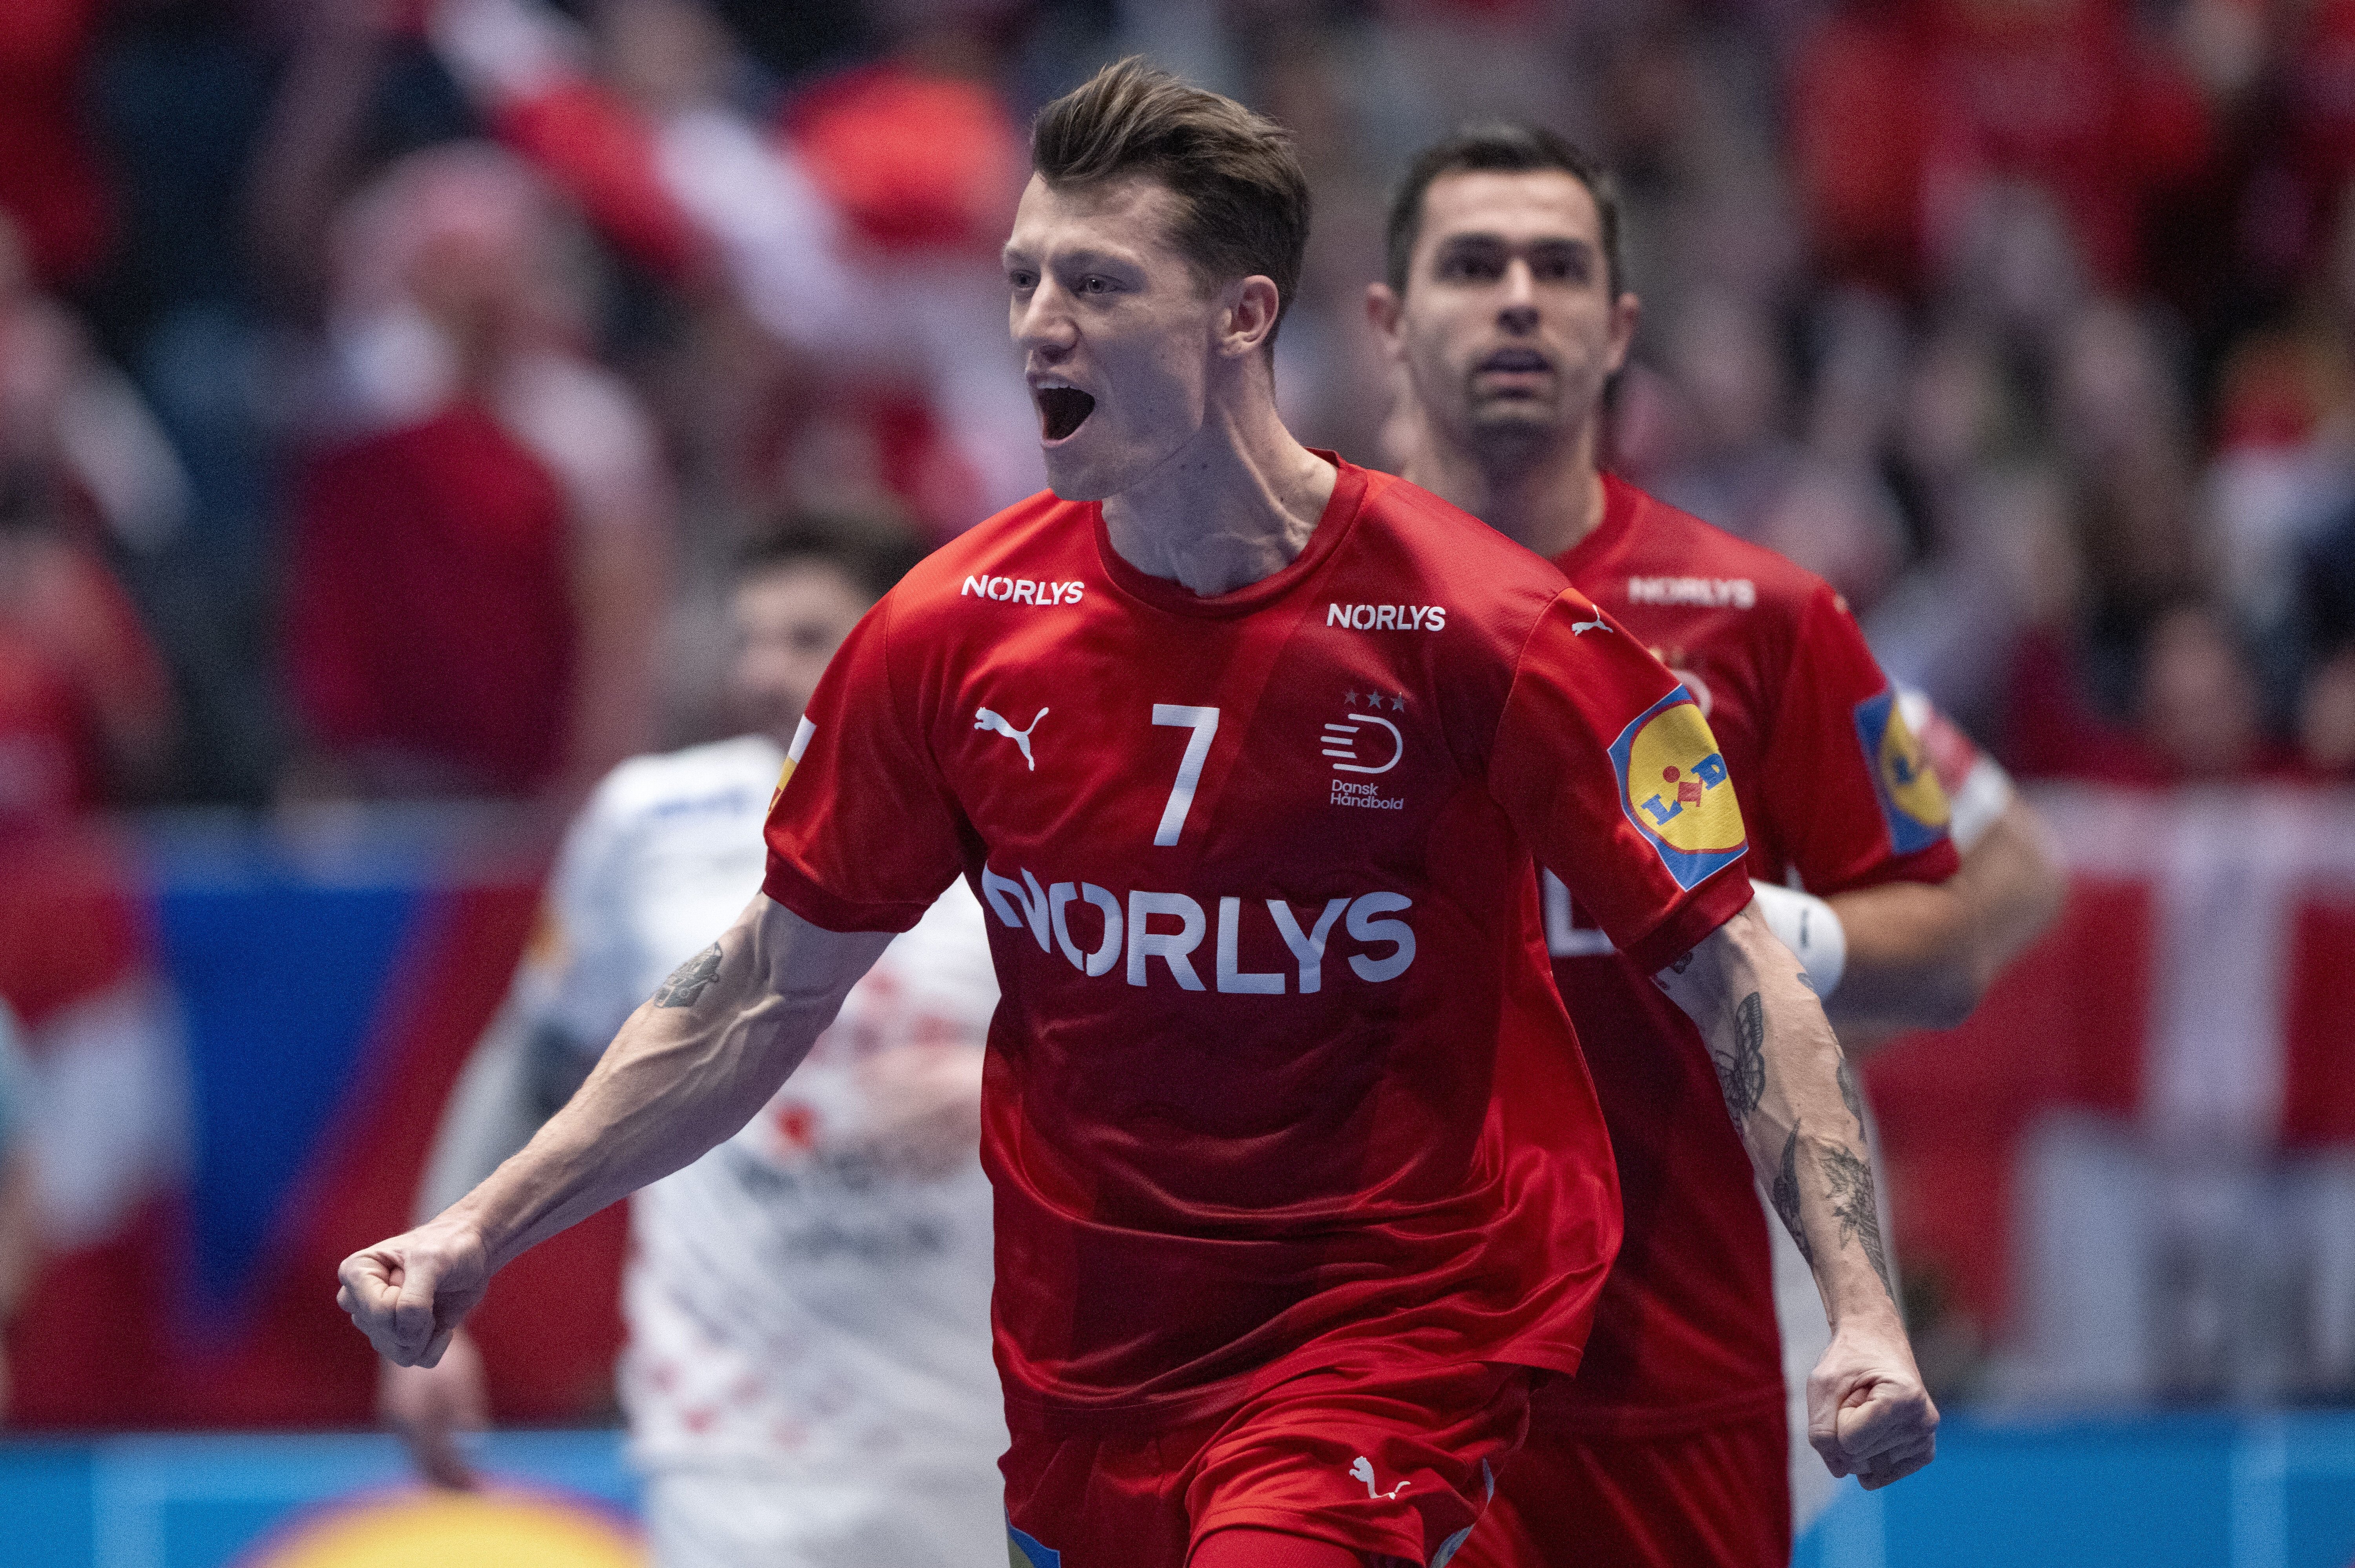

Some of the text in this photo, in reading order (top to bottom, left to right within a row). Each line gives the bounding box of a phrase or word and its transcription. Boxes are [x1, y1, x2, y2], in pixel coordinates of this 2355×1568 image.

[961, 575, 1085, 605] NORLYS
[1326, 603, 1446, 631] NORLYS
[1152, 704, 1220, 846] 7
[1332, 779, 1379, 796] Dansk
[1330, 792, 1404, 810] Håndbold
[981, 860, 1416, 994] NORLYS
